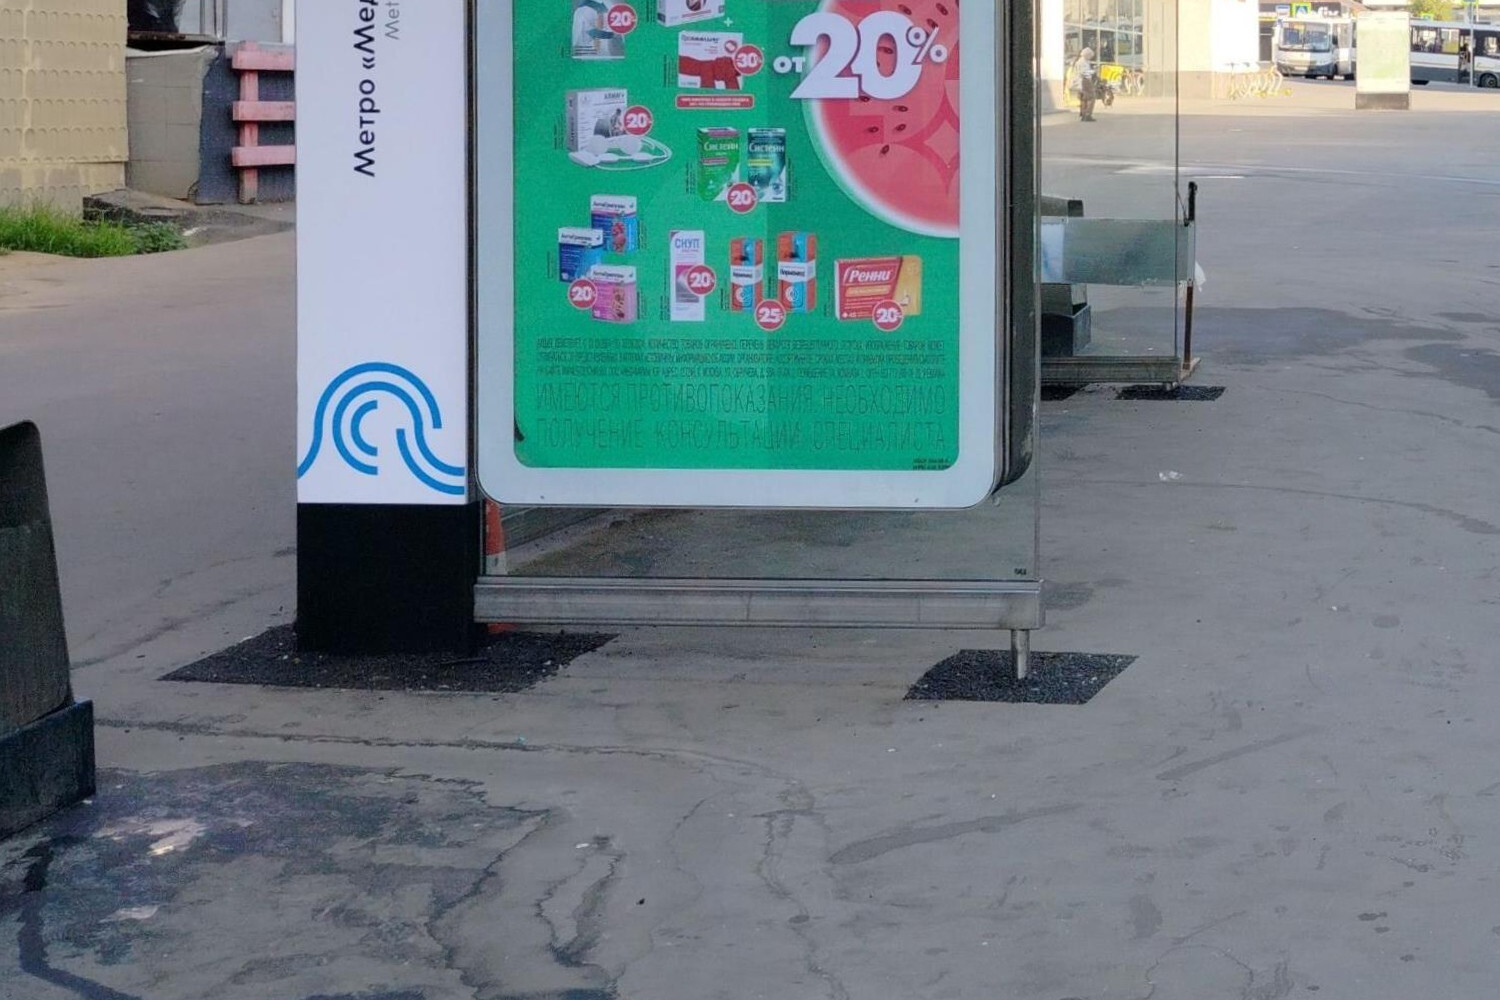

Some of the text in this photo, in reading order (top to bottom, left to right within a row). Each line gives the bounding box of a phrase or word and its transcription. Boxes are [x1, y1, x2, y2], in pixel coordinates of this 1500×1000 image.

[789, 10, 949, 100] 20%
[353, 79, 380, 178] Метро
[674, 238, 700, 249] СНУП
[849, 269, 891, 282] Ренни
[536, 383, 622, 414] ИМЕЮТСЯ
[823, 384, 946, 415] НЕОБХОДИМО
[536, 419, 946, 452] ПОЛУЧЕНИЕ КОНСУЛЬТАЦИИ СПЕЦИАЛИСТА
